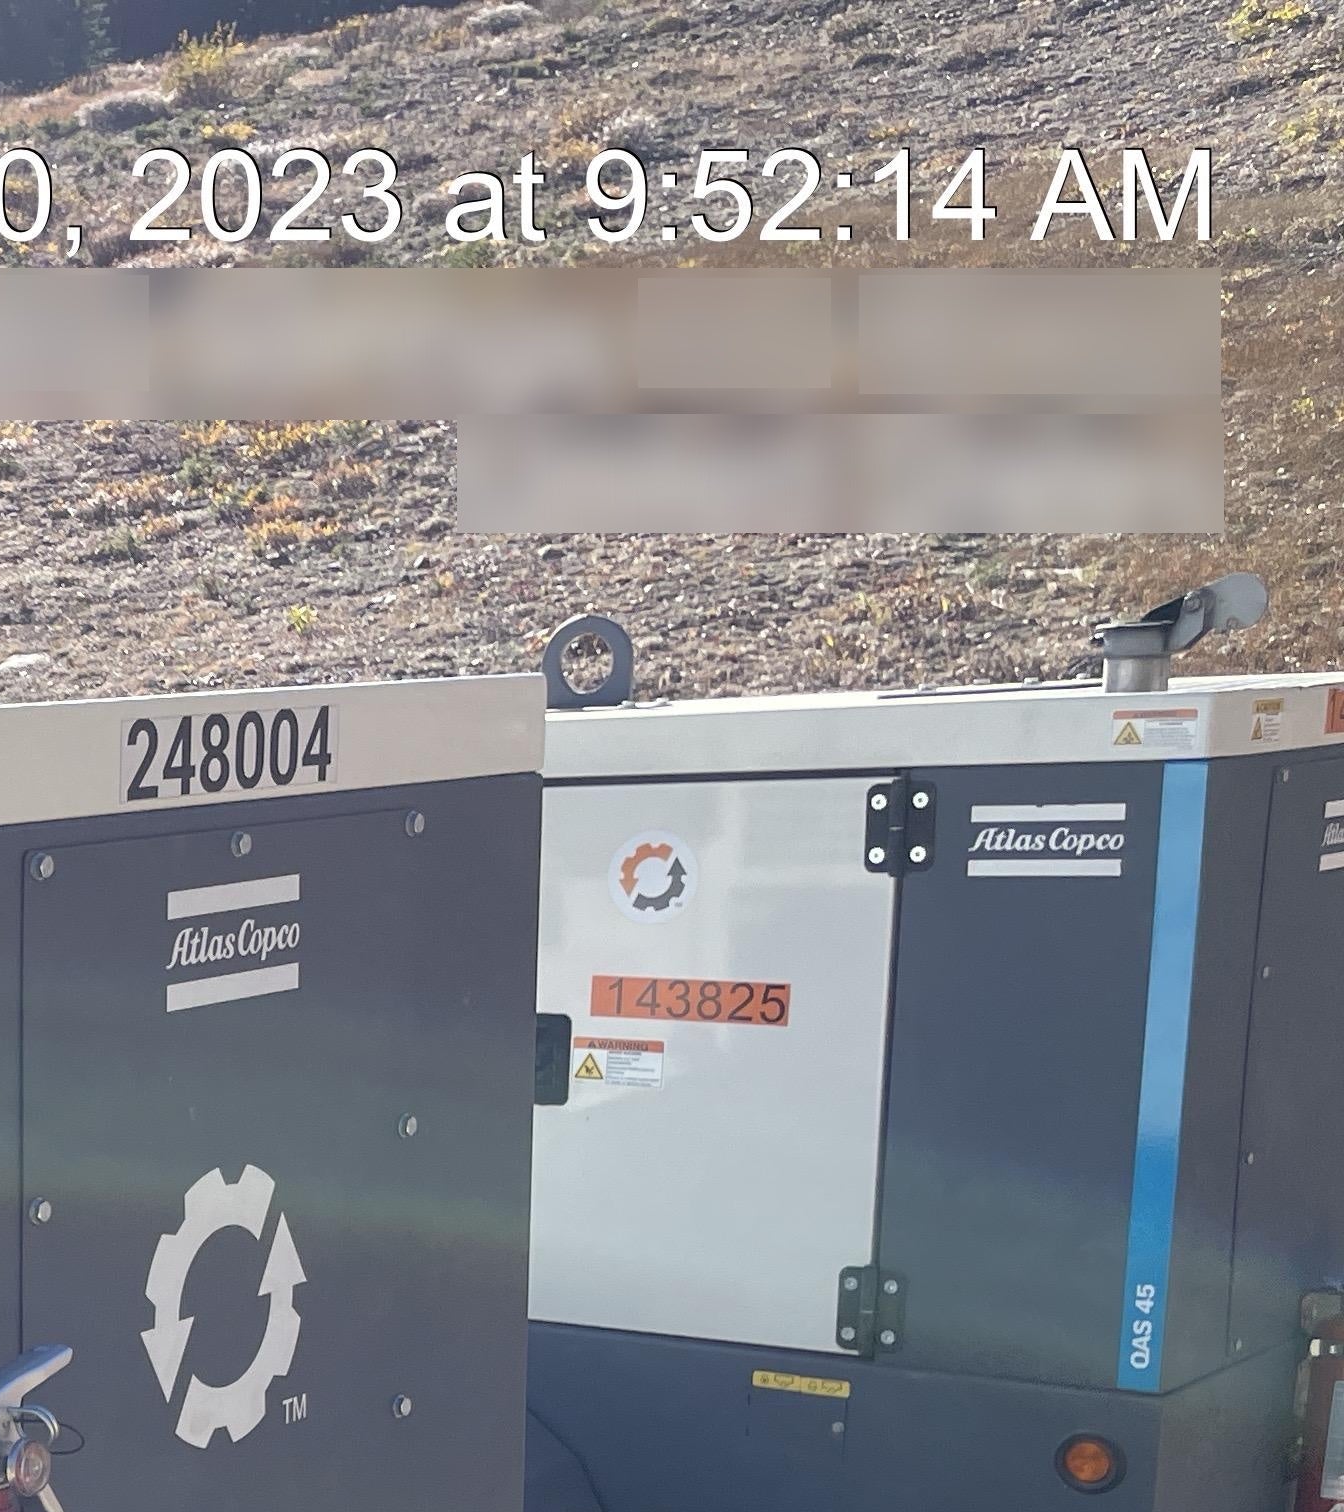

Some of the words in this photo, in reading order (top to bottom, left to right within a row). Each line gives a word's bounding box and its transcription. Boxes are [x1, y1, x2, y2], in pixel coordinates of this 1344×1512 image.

[126, 705, 332, 801] 248004
[968, 827, 1046, 852] Atlas
[1049, 826, 1124, 856] Copco
[165, 926, 235, 970] Atlas
[237, 919, 300, 961] Copco
[609, 977, 786, 1024] 143825
[1135, 1284, 1155, 1314] 45
